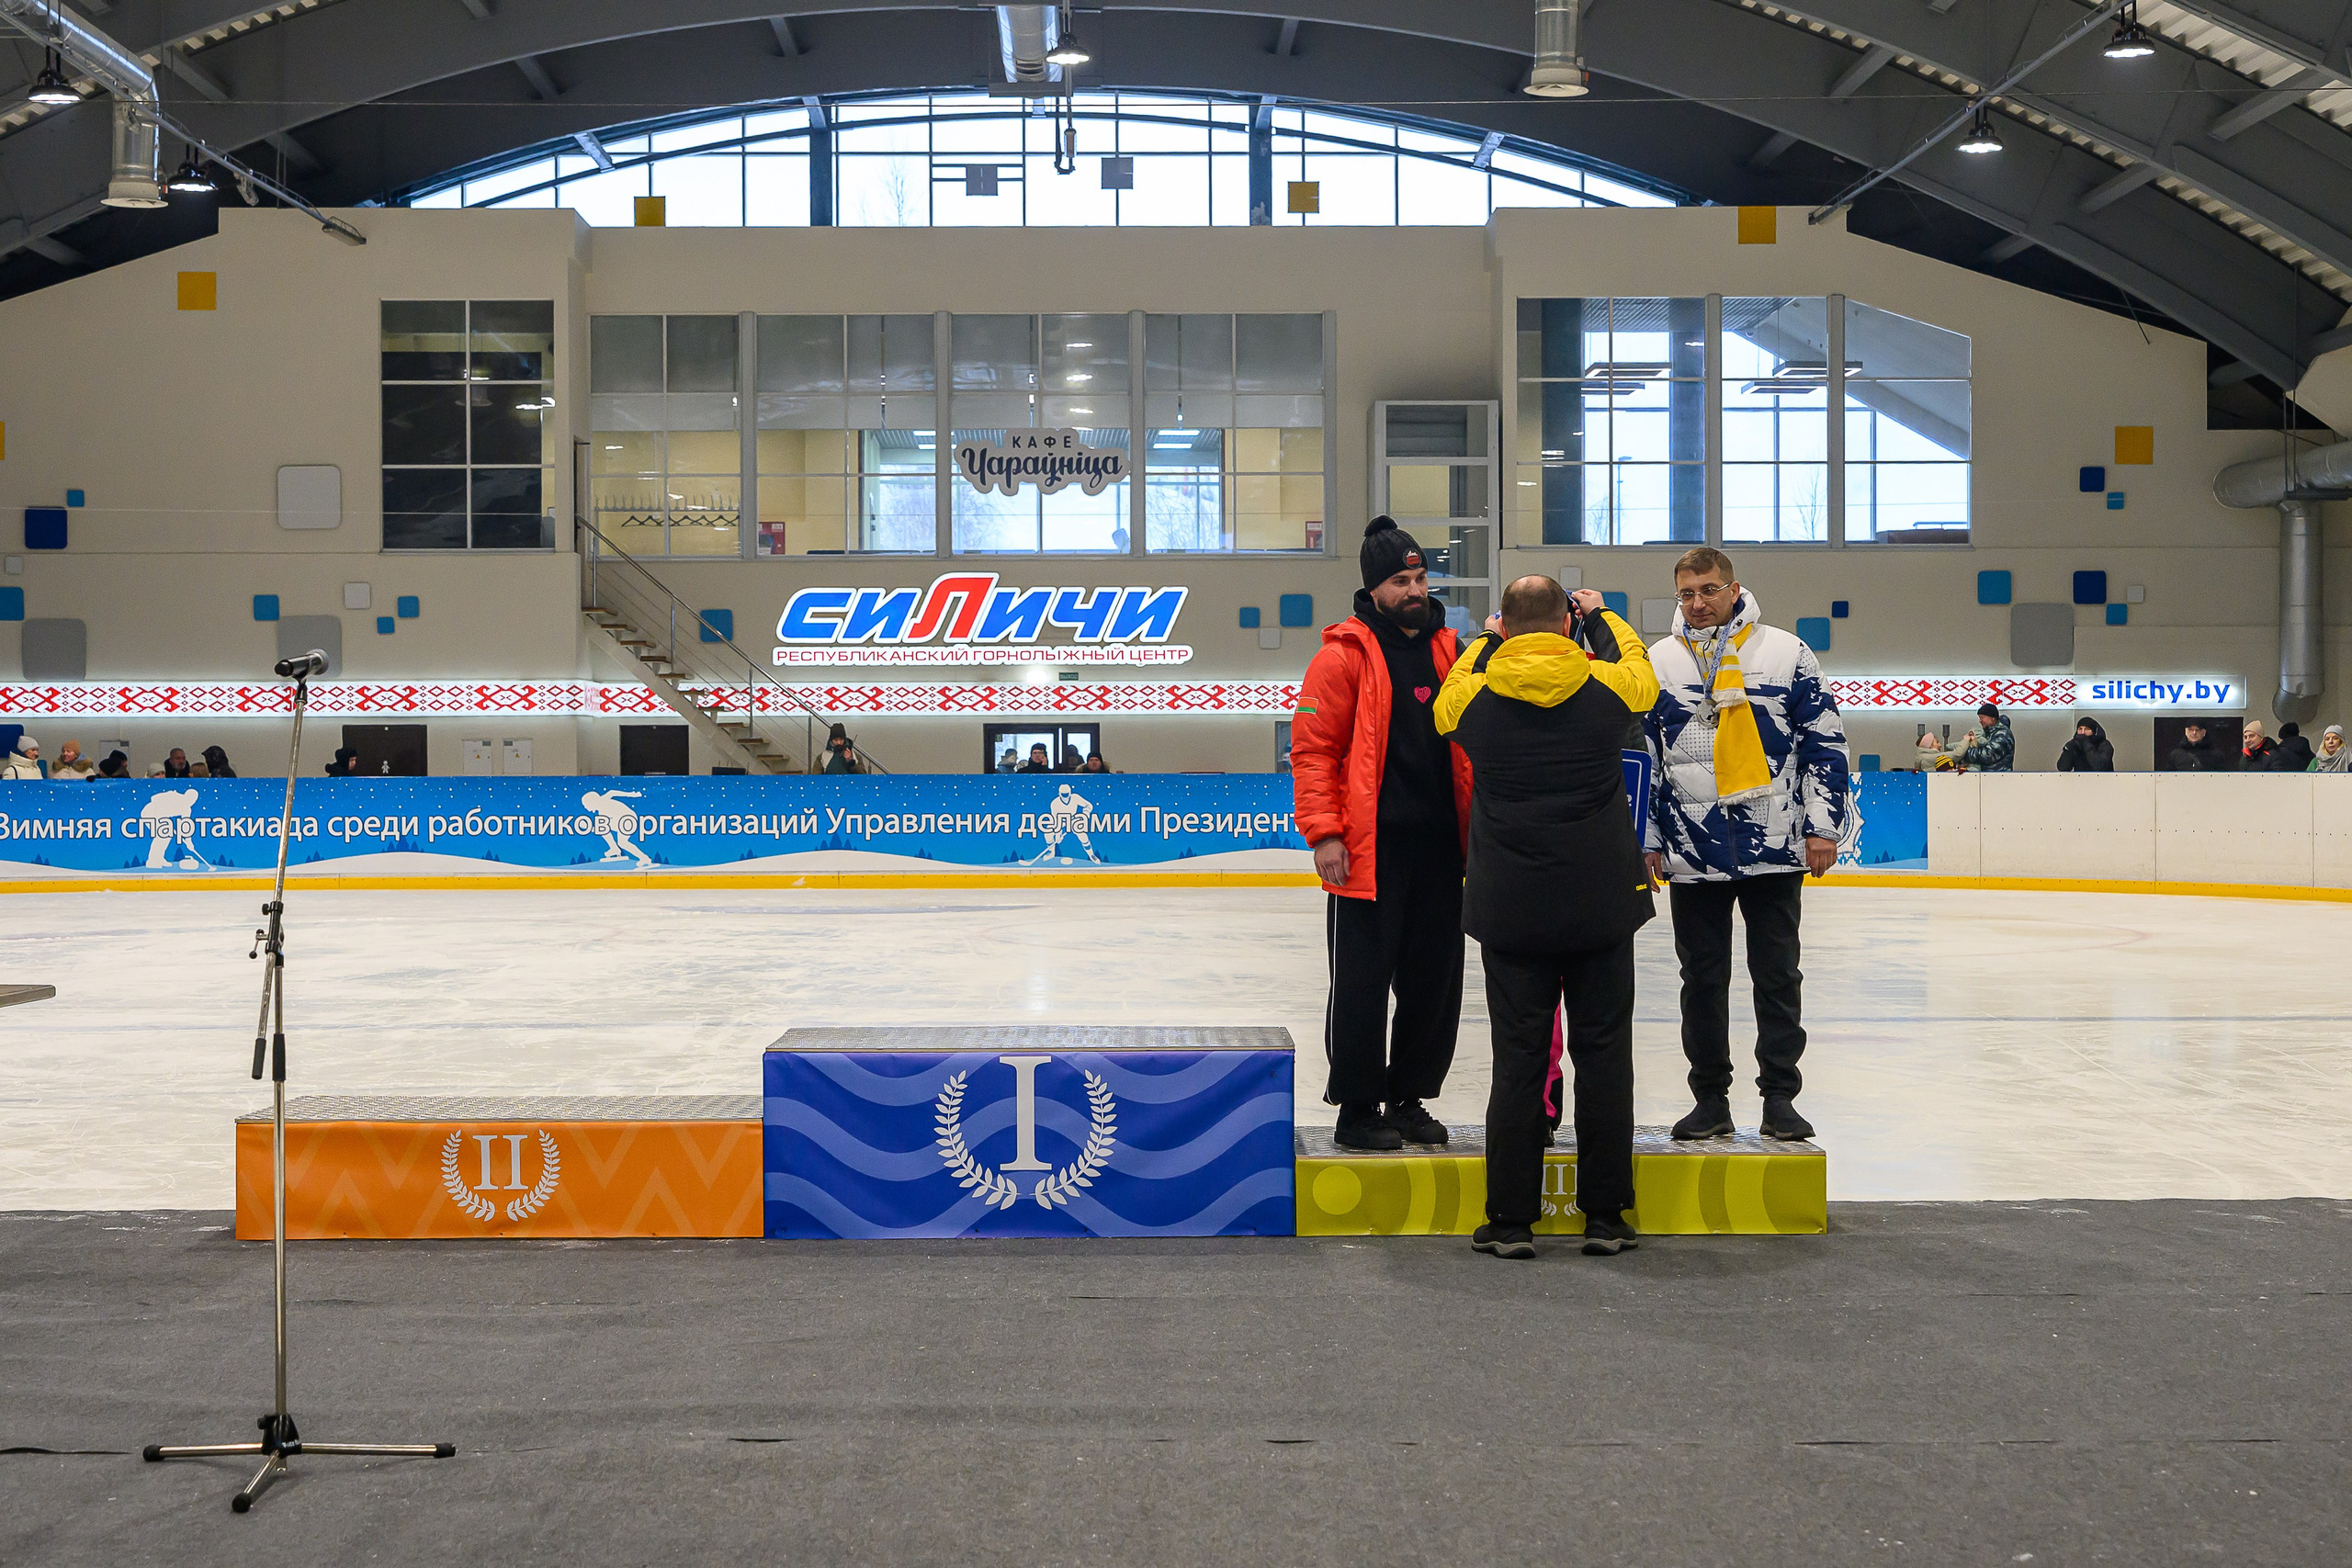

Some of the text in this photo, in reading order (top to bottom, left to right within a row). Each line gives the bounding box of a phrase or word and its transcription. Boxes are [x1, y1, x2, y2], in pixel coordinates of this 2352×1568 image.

[1012, 435, 1072, 449] КАФЕ
[961, 447, 1124, 489] Чараўніца
[776, 647, 1190, 663] РЕСПУБЛИКАНСКИЙ ГОРНОЛЫЖНЫЙ ЦЕНТР
[2092, 680, 2231, 704] silichy.by
[0, 806, 1300, 844] Зимняя спартакиада среди работников организаций Управления делами Президен
[999, 1055, 1053, 1171] I
[472, 1134, 529, 1190] II
